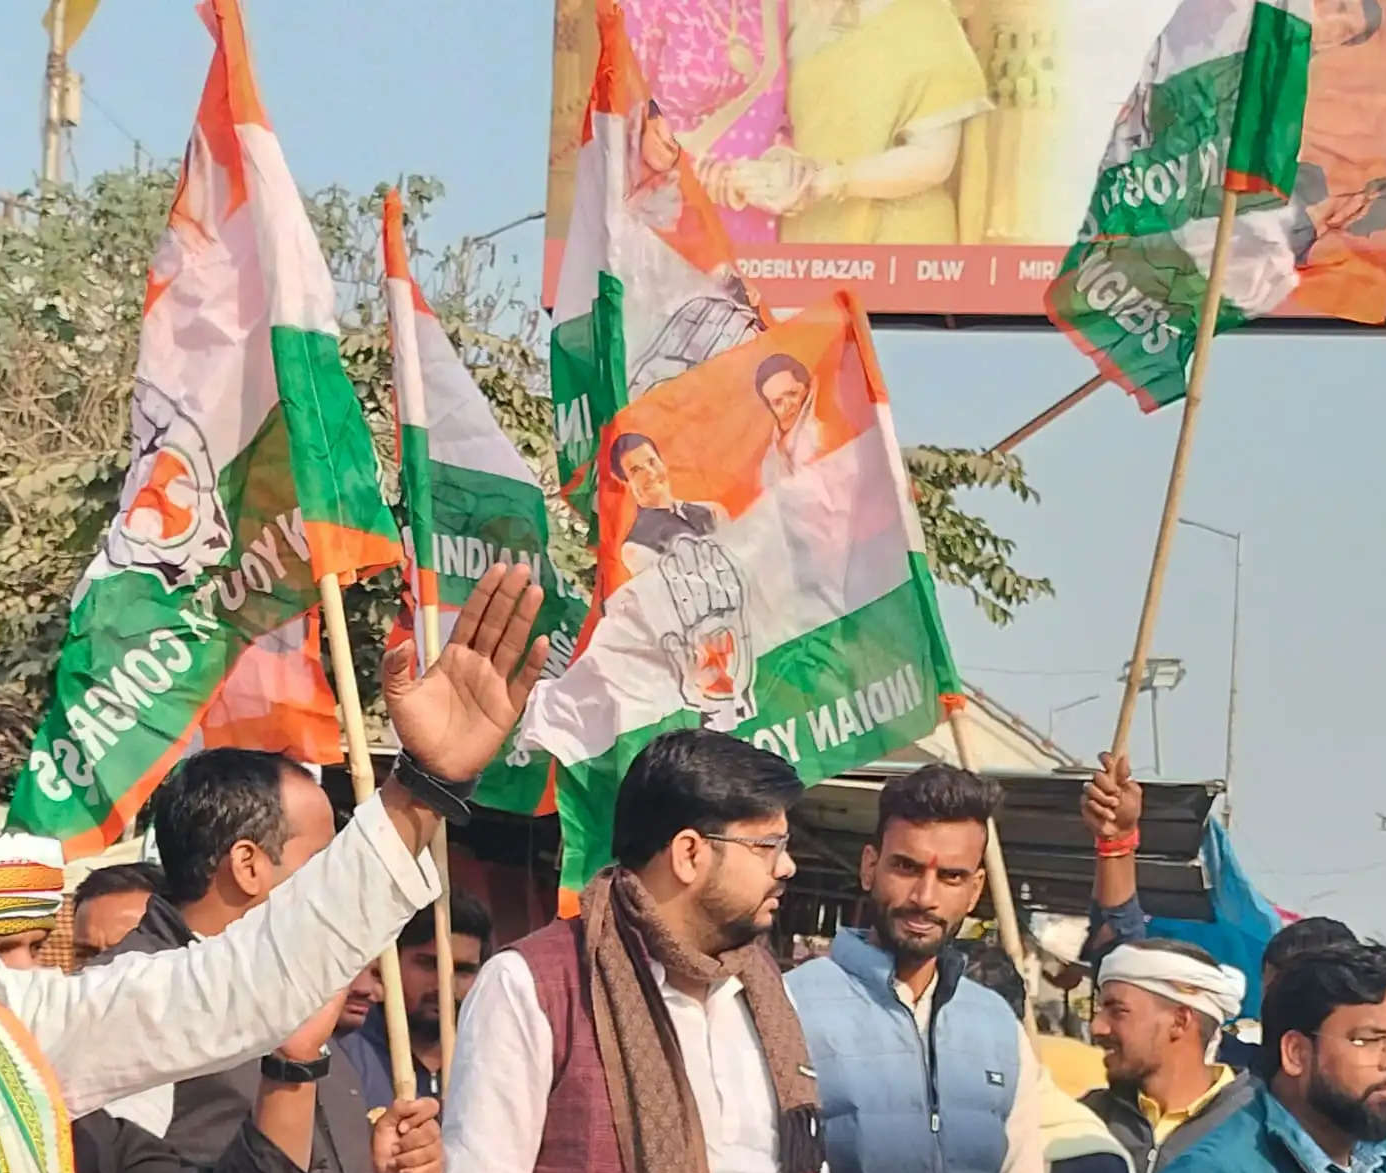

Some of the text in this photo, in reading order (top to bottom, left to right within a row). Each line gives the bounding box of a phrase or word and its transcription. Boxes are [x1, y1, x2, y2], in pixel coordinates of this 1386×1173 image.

[736, 259, 810, 279] RDERLY
[811, 259, 875, 280] BAZAR
[916, 259, 965, 281] DLW
